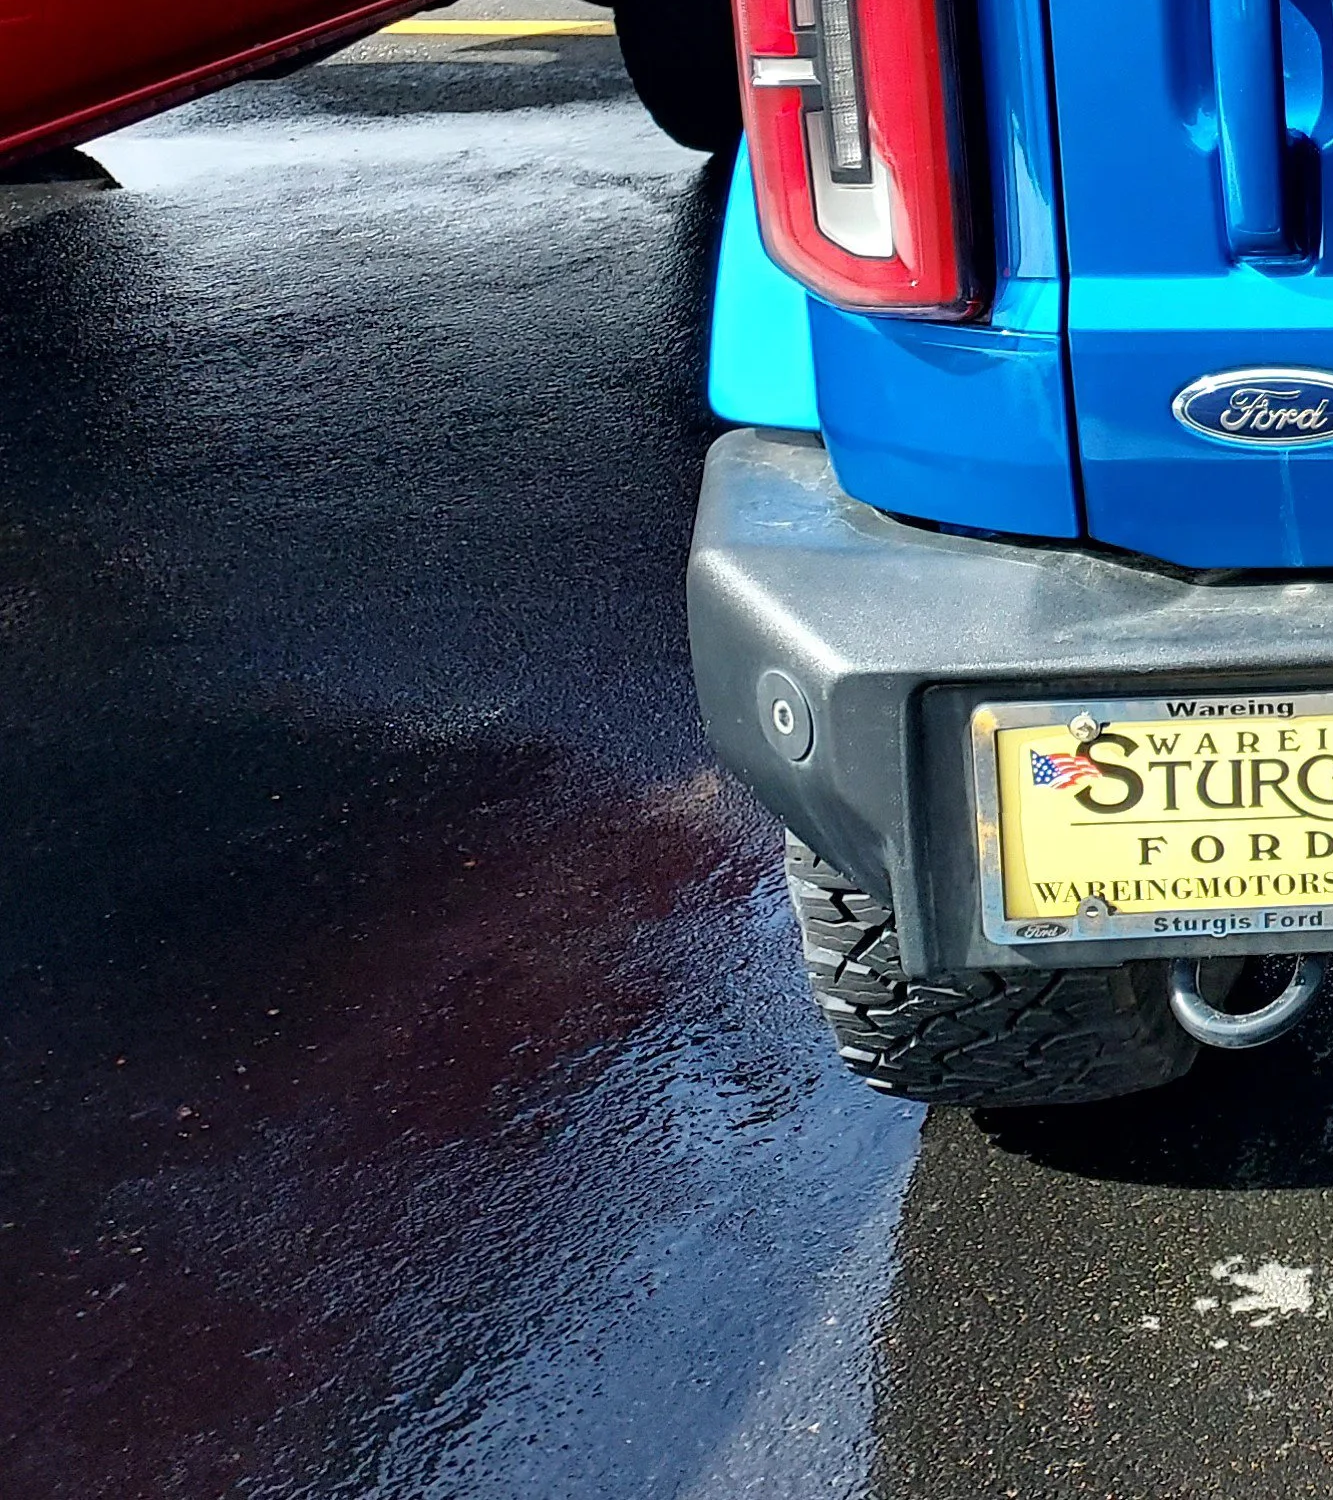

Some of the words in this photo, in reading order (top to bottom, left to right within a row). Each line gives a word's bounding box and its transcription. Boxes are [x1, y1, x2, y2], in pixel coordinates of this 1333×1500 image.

[1220, 388, 1330, 431] Ford
[1167, 699, 1295, 719] Wareing
[1153, 912, 1250, 936] Sturgis
[1263, 909, 1324, 929] Ford
